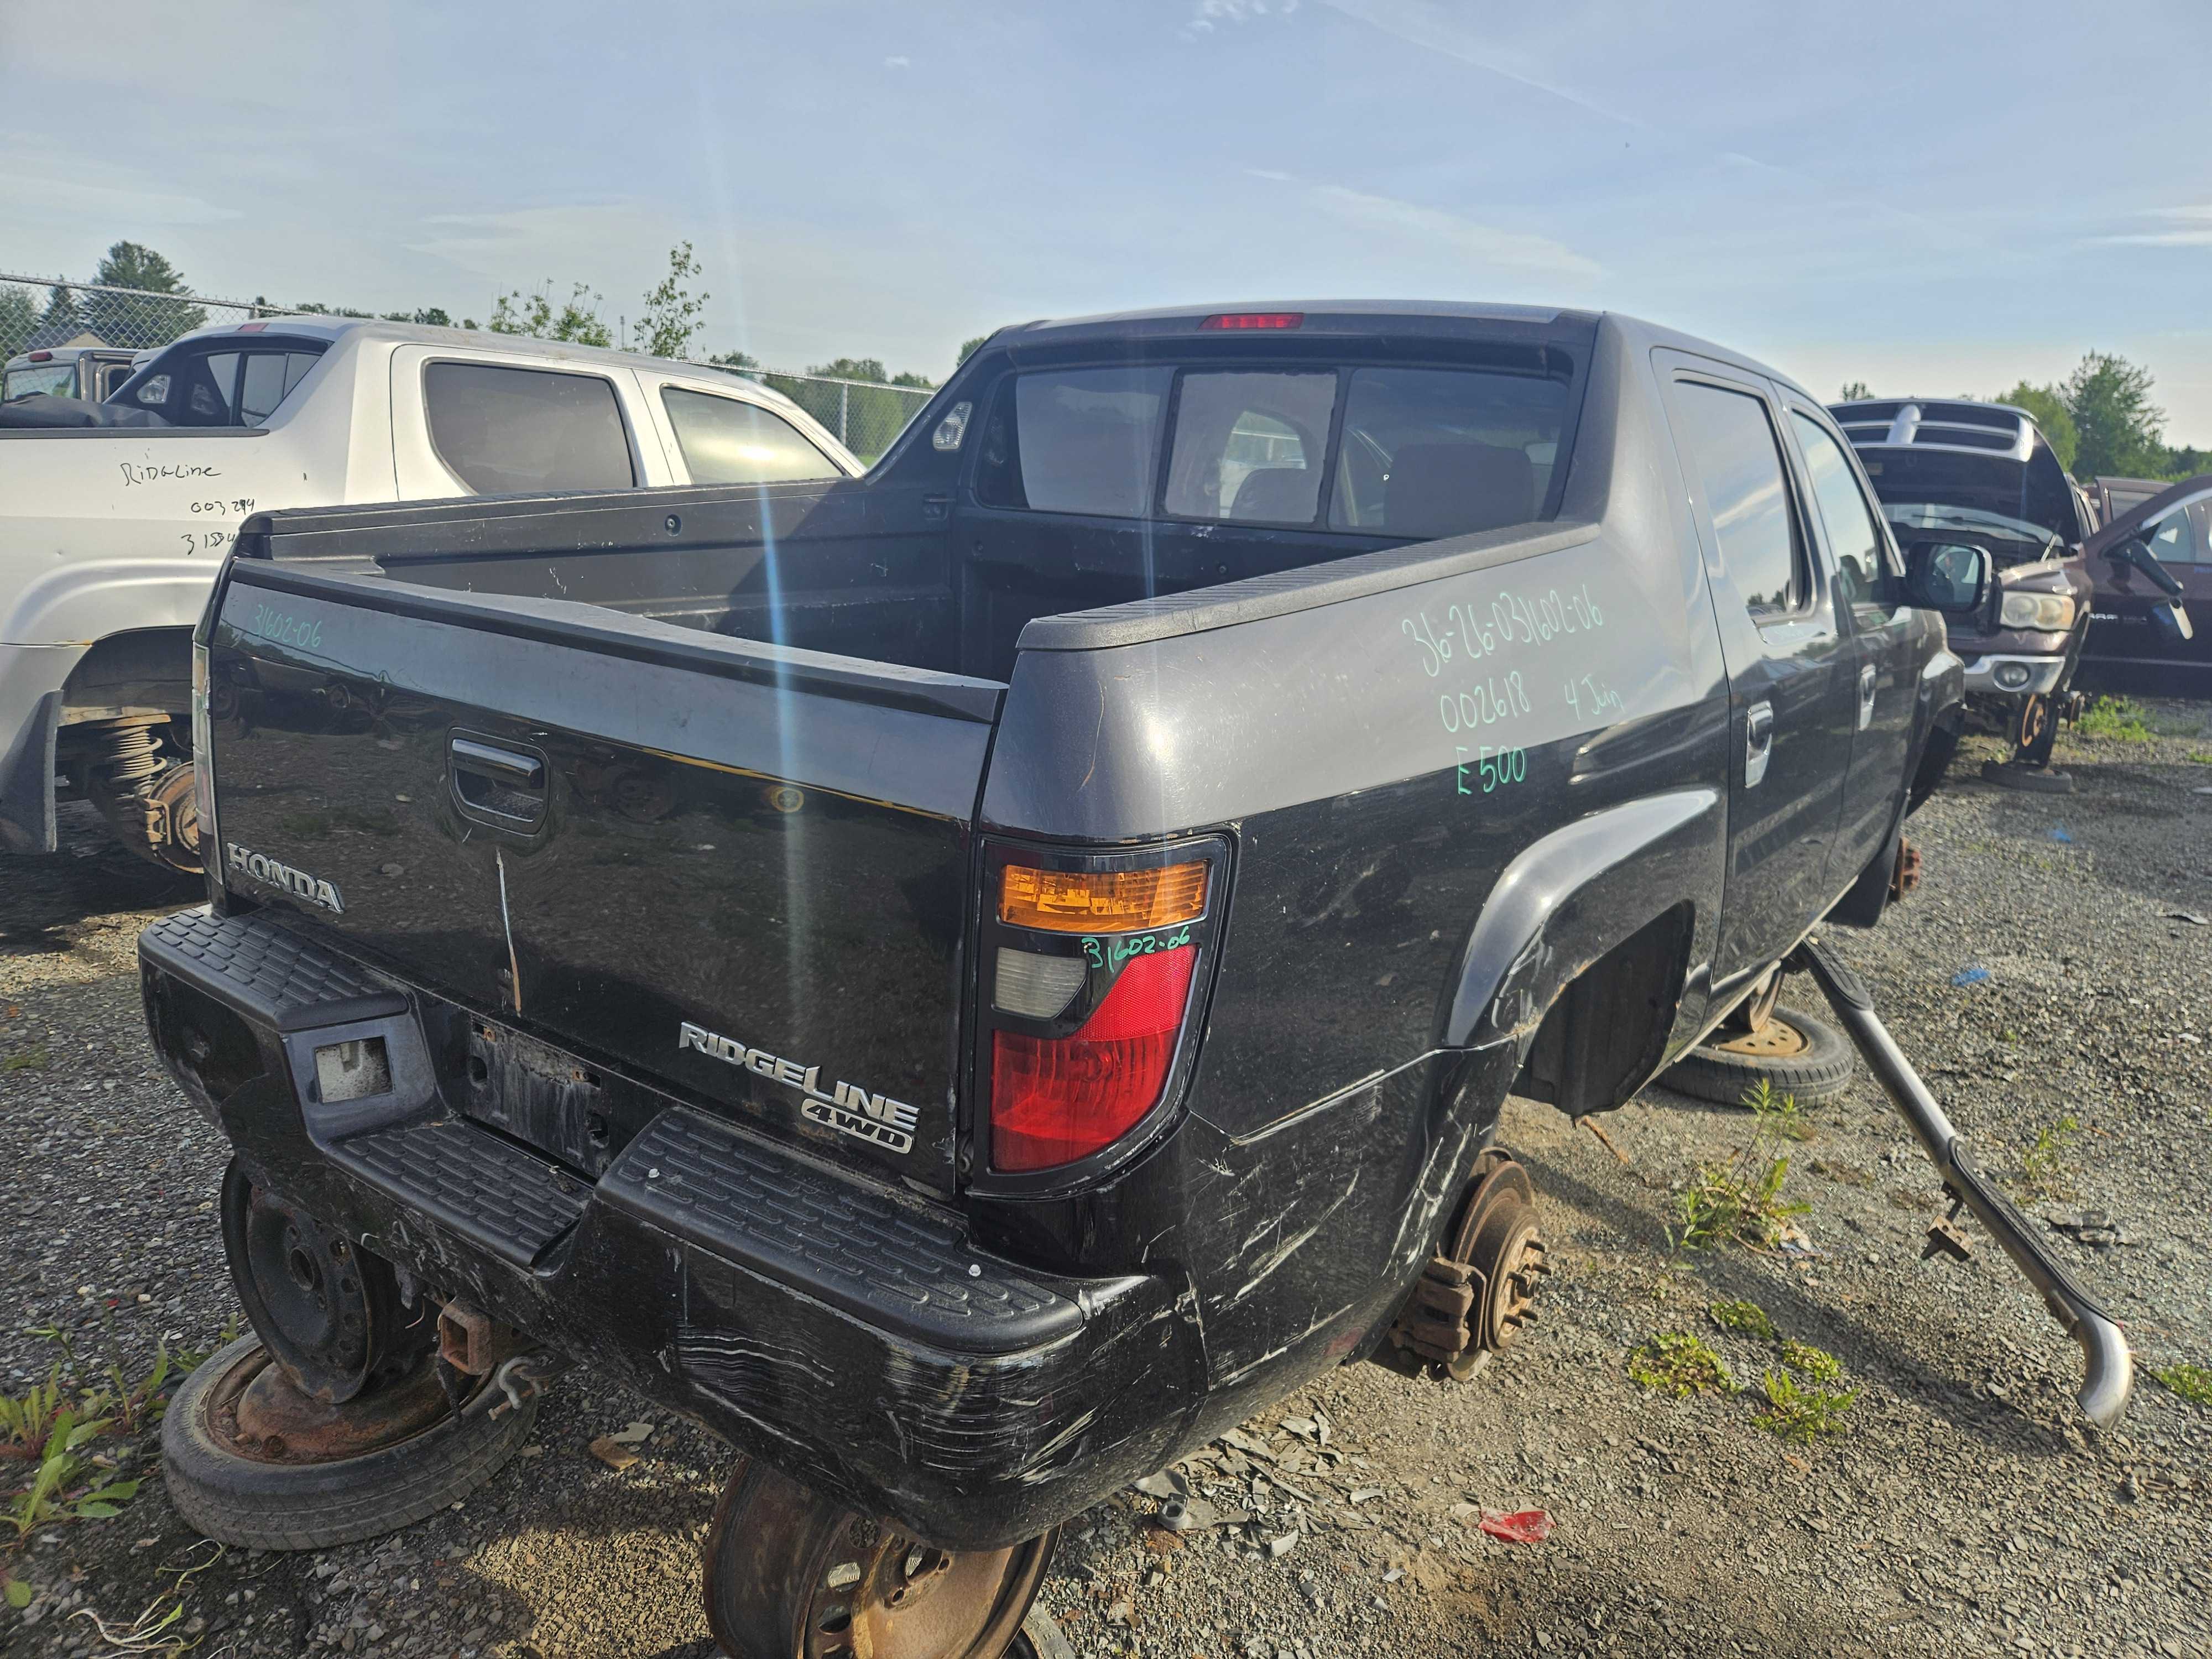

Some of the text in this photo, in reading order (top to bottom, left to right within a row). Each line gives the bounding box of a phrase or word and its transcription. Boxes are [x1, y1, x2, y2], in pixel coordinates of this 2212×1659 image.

[1440, 670, 1531, 733] 002618
[227, 842, 346, 914] HONDA
[1082, 925, 1190, 973] 31602-06
[679, 1021, 920, 1132] RIDGELINE
[806, 1104, 907, 1149] 4WD
